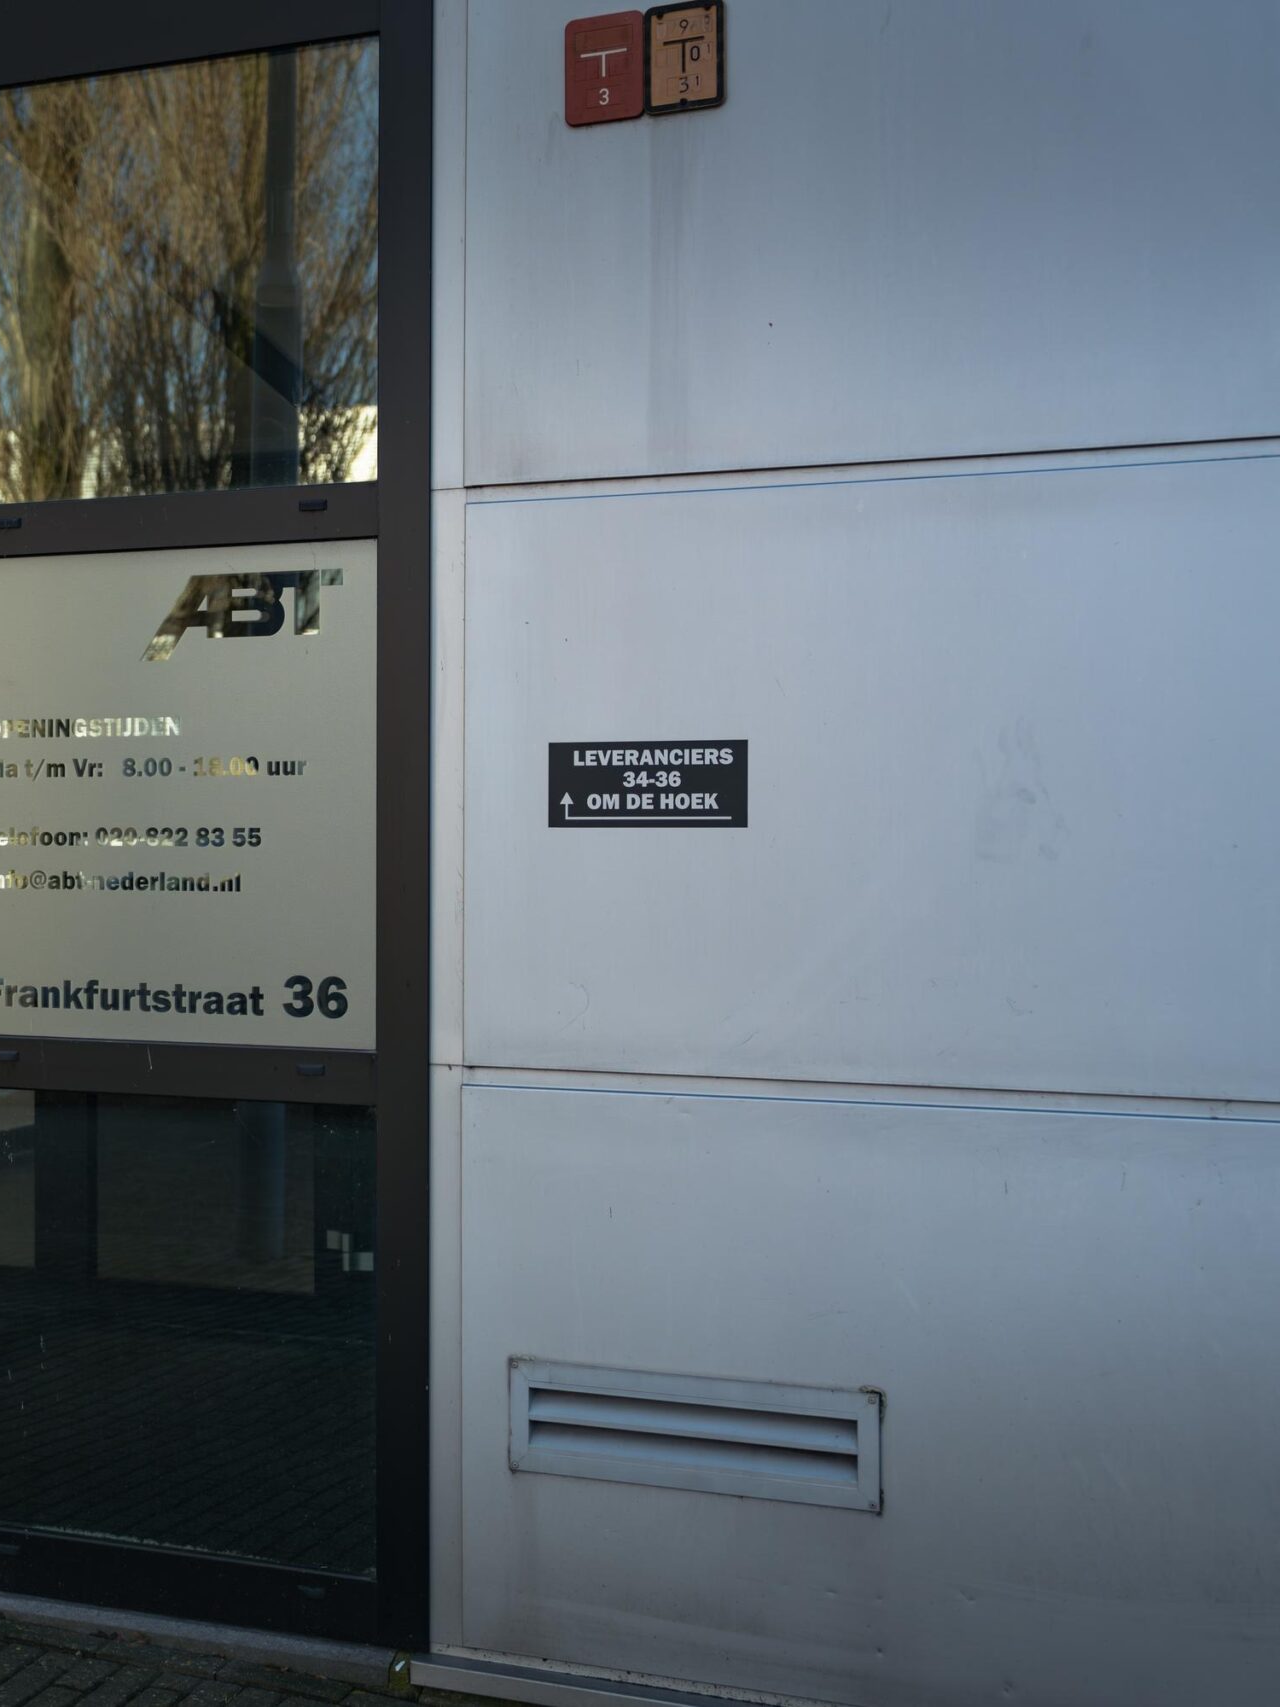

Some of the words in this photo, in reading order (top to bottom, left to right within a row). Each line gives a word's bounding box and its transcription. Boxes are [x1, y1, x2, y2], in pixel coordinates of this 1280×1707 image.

[599, 88, 610, 105] 3
[140, 568, 343, 662] ABT
[573, 748, 734, 767] LEVERANCIERS
[24, 758, 66, 782] t/m
[72, 758, 104, 778] Vr:
[122, 757, 172, 778] 8.00
[267, 760, 307, 776] uur
[622, 771, 682, 788] 34-36
[586, 793, 620, 810] OM
[626, 793, 655, 810] DE
[659, 792, 719, 810] HOEK
[195, 827, 225, 847] 83
[232, 827, 262, 847] 55
[282, 974, 349, 1019] 36
